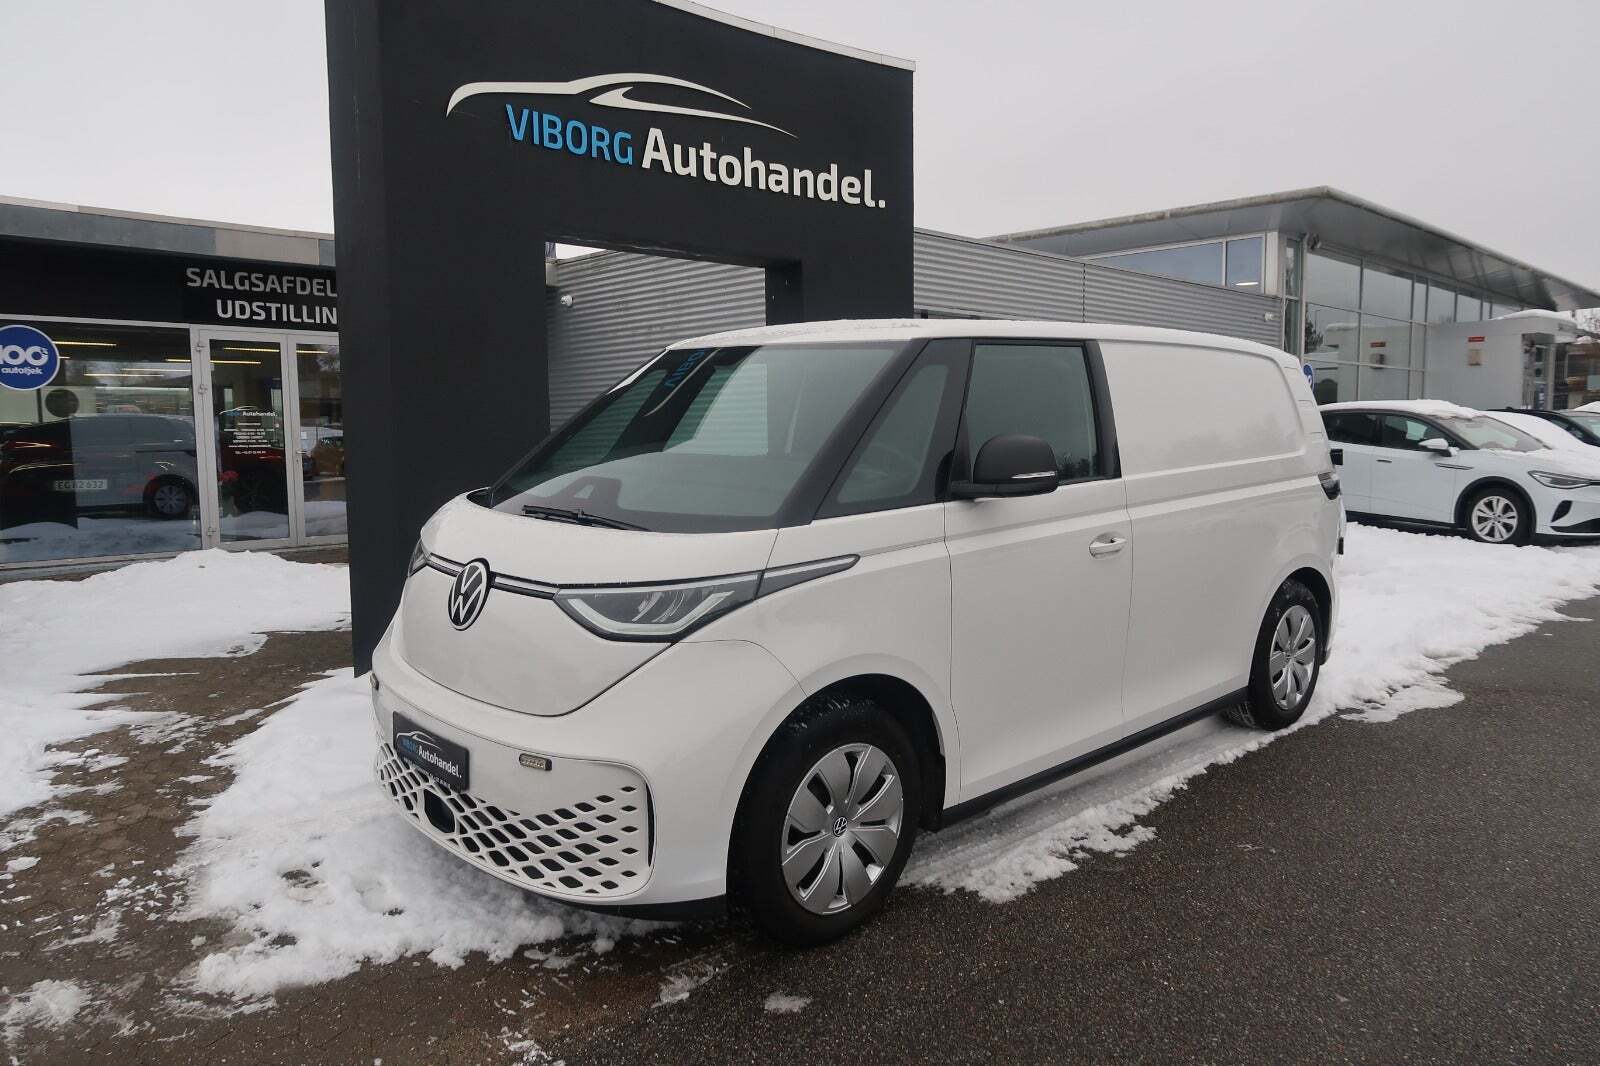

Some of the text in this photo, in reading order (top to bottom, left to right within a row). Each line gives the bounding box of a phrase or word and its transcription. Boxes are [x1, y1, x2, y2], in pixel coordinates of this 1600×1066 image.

[505, 103, 886, 209] VIBORG Autohandel.
[185, 267, 338, 297] SALGSAFDEL
[216, 299, 338, 325] UDSTILLIN
